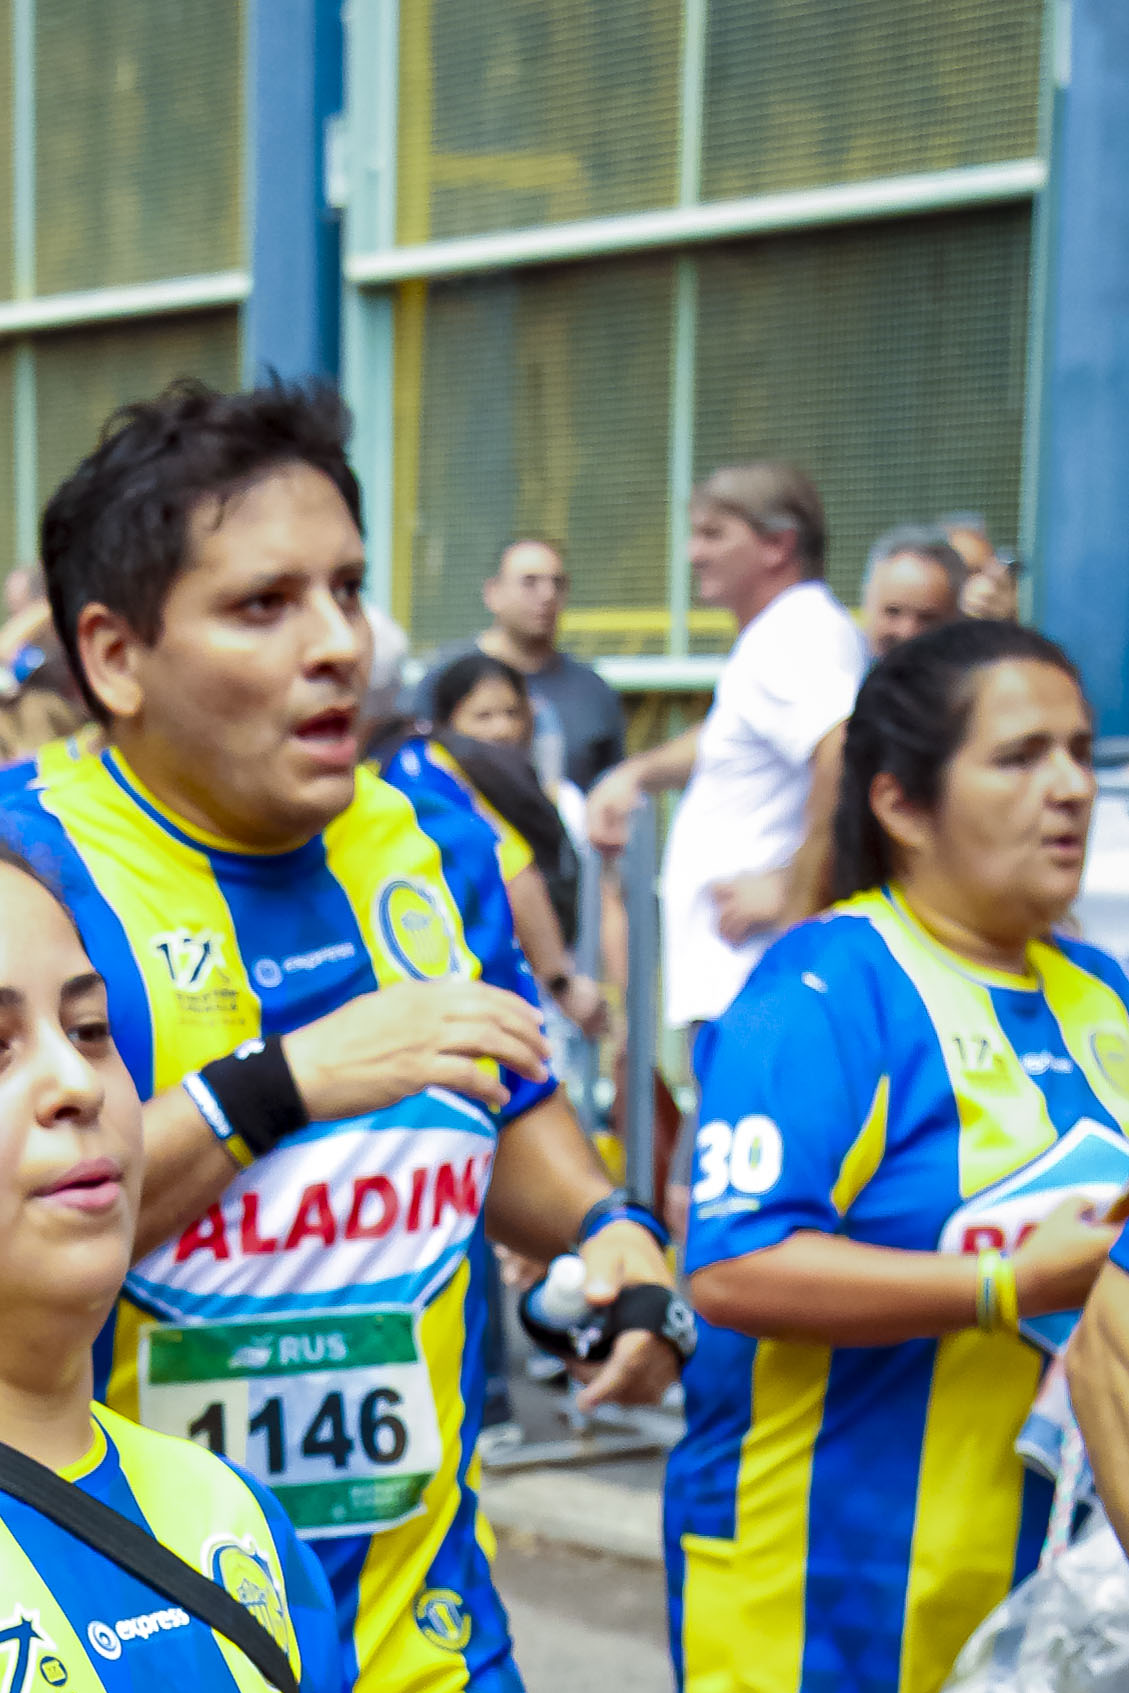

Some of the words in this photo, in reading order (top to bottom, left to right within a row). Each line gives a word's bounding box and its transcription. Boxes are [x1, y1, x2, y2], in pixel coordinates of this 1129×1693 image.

[156, 936, 212, 984] 17
[693, 1114, 783, 1204] 30
[175, 1152, 491, 1264] ALADIN
[278, 1333, 348, 1365] RUS
[188, 1388, 407, 1473] 1146
[115, 1608, 190, 1639] express
